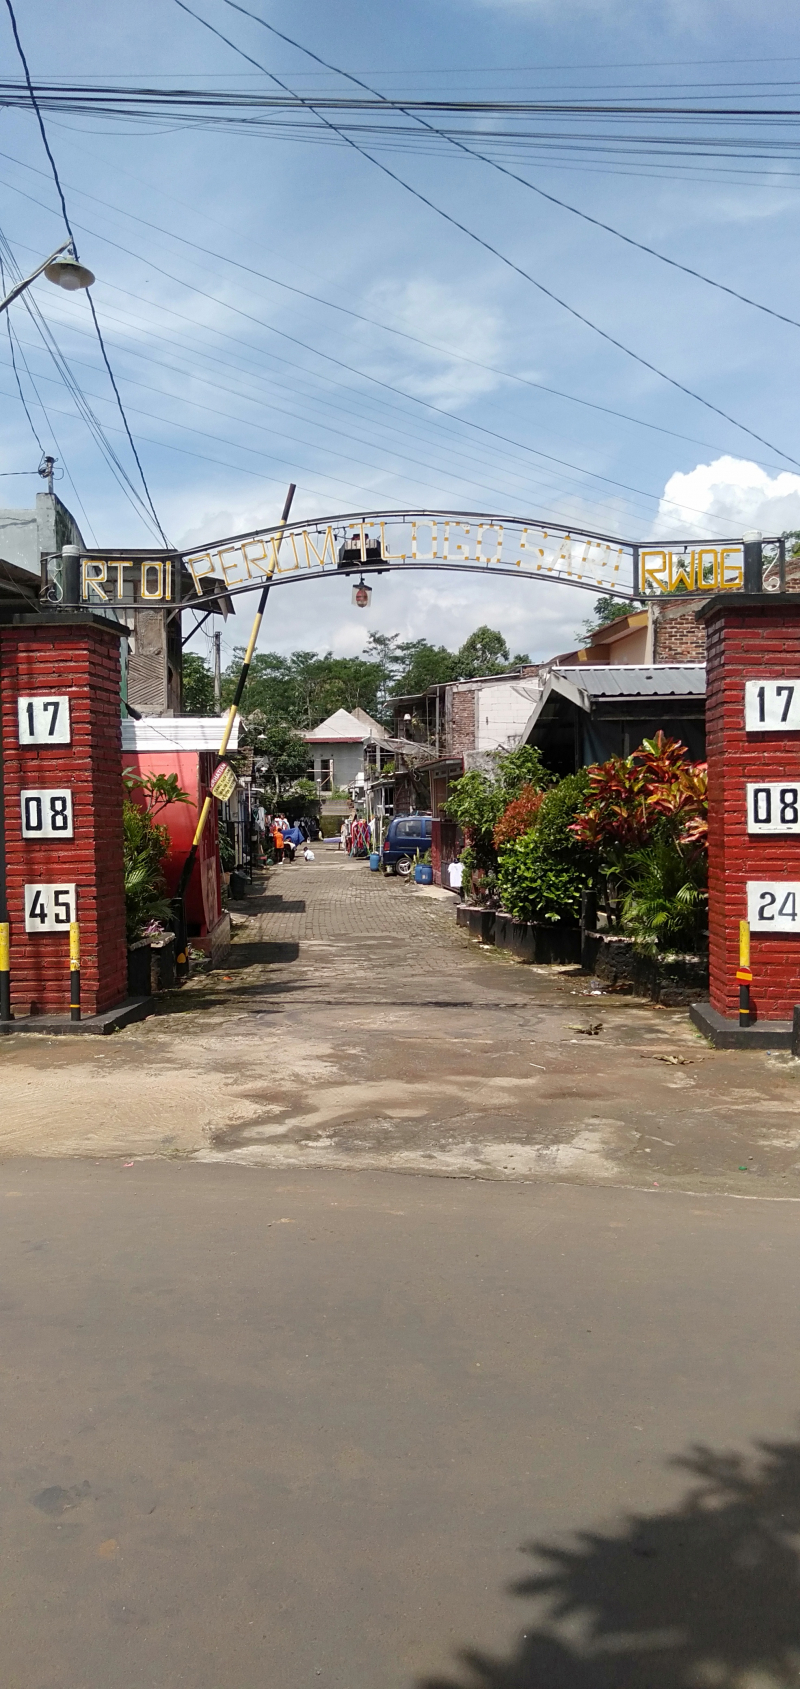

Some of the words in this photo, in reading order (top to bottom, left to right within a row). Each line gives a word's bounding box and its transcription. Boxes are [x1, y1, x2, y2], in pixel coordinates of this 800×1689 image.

[188, 525, 336, 595] PERUM
[350, 520, 503, 563] TLOGO
[516, 527, 623, 588] SARI
[83, 561, 133, 600] RT
[26, 701, 60, 736] 17
[756, 686, 795, 723] 17
[25, 796, 68, 831] 08
[753, 788, 799, 824] 08
[29, 890, 70, 924] 45
[758, 891, 798, 921] 24
